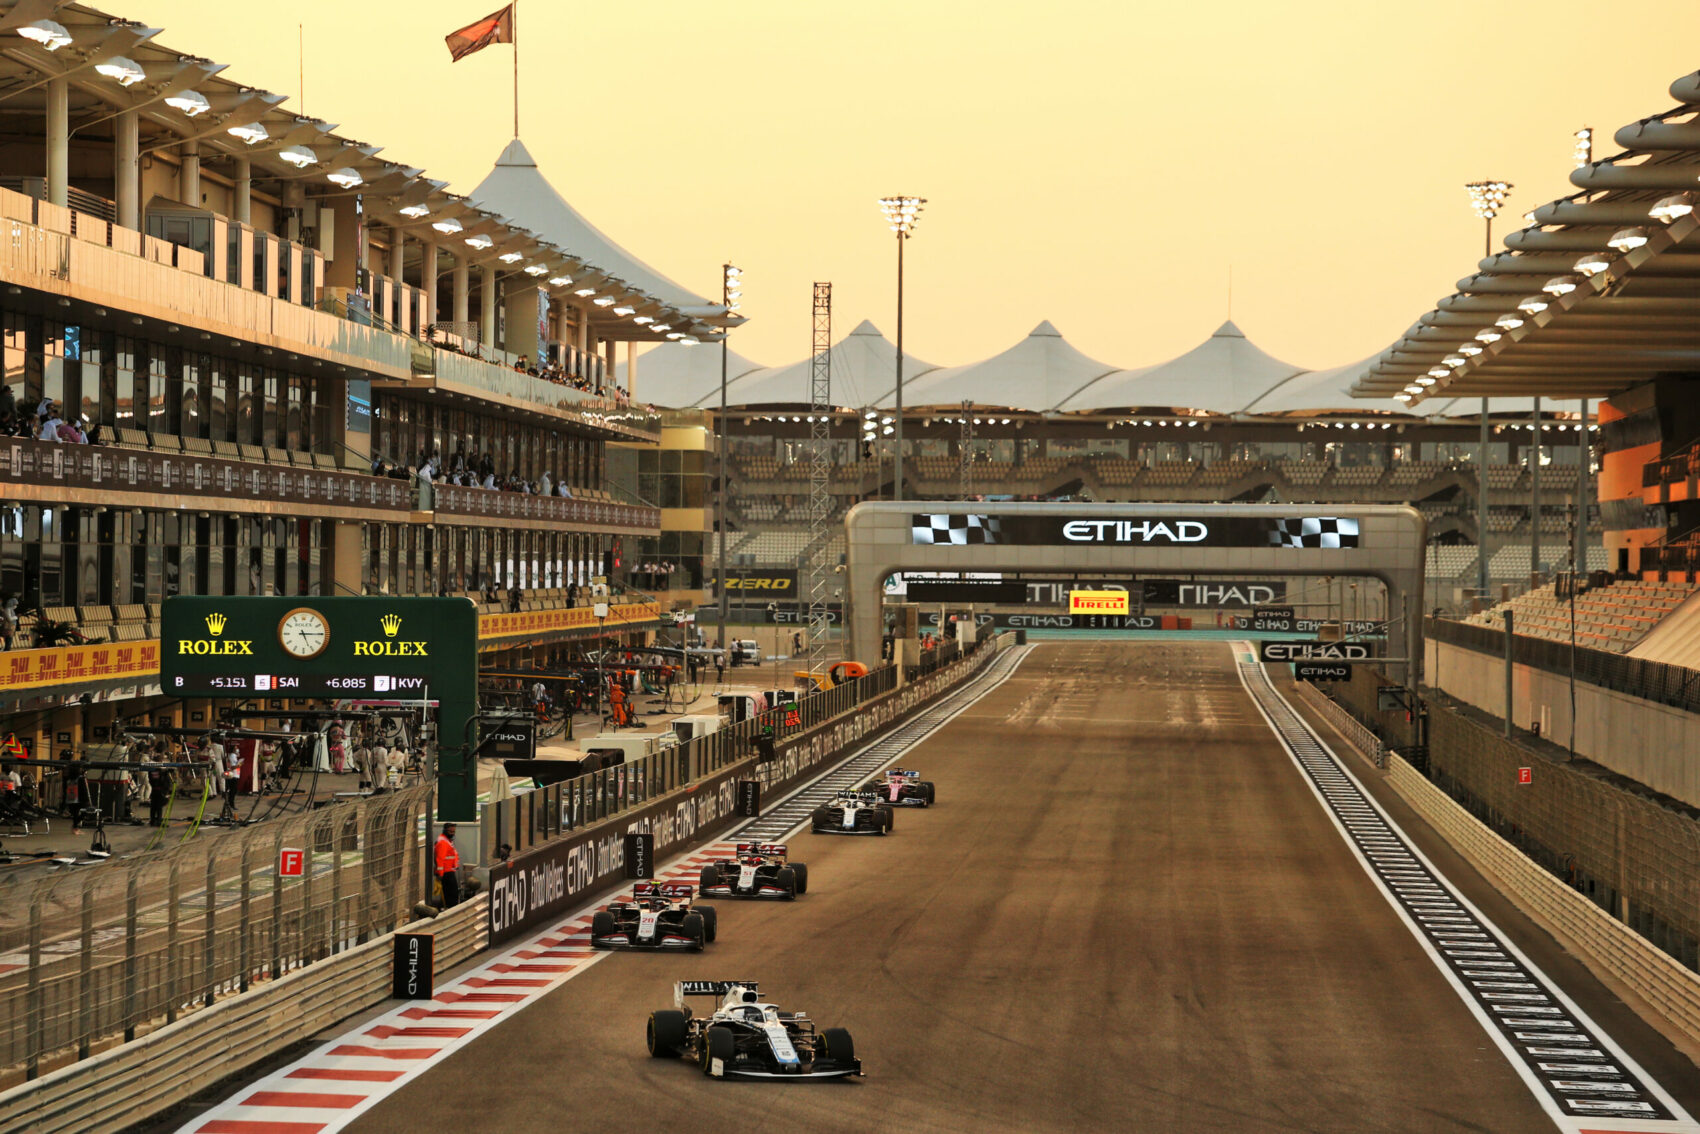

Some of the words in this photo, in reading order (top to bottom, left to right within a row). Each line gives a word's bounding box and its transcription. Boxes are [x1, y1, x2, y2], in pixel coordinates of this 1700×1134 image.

[1063, 521, 1208, 542] ETIHAD
[724, 578, 791, 589] ZERO
[1073, 597, 1125, 608] PIRELLI
[1179, 585, 1274, 605] TIHAD
[1008, 616, 1072, 627] ETIHAD
[178, 640, 253, 655] ROLEX
[353, 641, 428, 656] ROLEX
[1265, 644, 1367, 659] ETIHAD
[1300, 667, 1346, 675] ETIHAD
[175, 676, 184, 687] B
[210, 677, 247, 688] +5.151
[279, 677, 299, 688] SAI
[326, 678, 366, 688] +6.085
[398, 678, 423, 688] KVY
[1521, 769, 1528, 781] F
[286, 854, 298, 873] F
[636, 836, 644, 877] ETIHAD
[567, 840, 595, 895] ETIHAD
[492, 869, 527, 933] ETIHAD
[408, 937, 419, 996] ETIHAD
